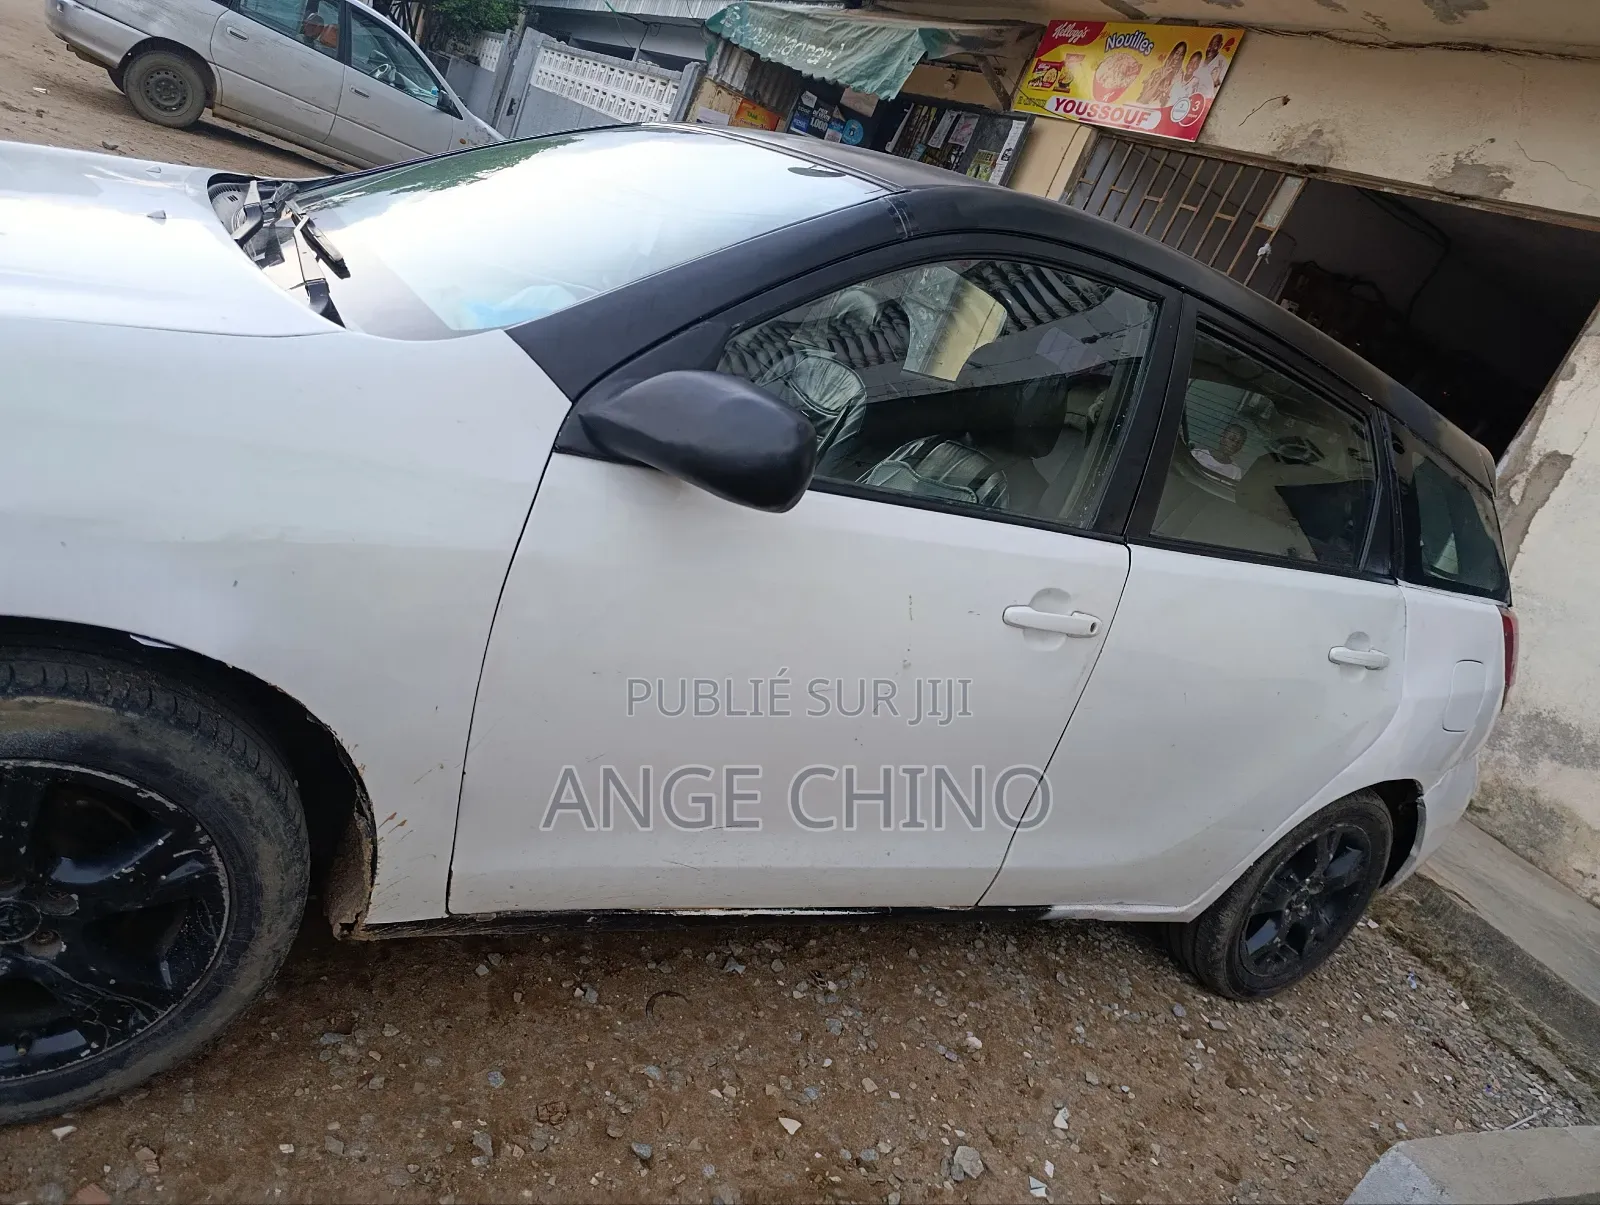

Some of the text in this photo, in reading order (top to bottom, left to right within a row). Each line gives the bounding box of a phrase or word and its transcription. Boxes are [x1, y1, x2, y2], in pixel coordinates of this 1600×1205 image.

[1052, 21, 1090, 43] Kellogg's
[1105, 30, 1154, 56] Nouilles
[1053, 97, 1152, 127] YOUSSOUF
[1192, 100, 1201, 112] 3
